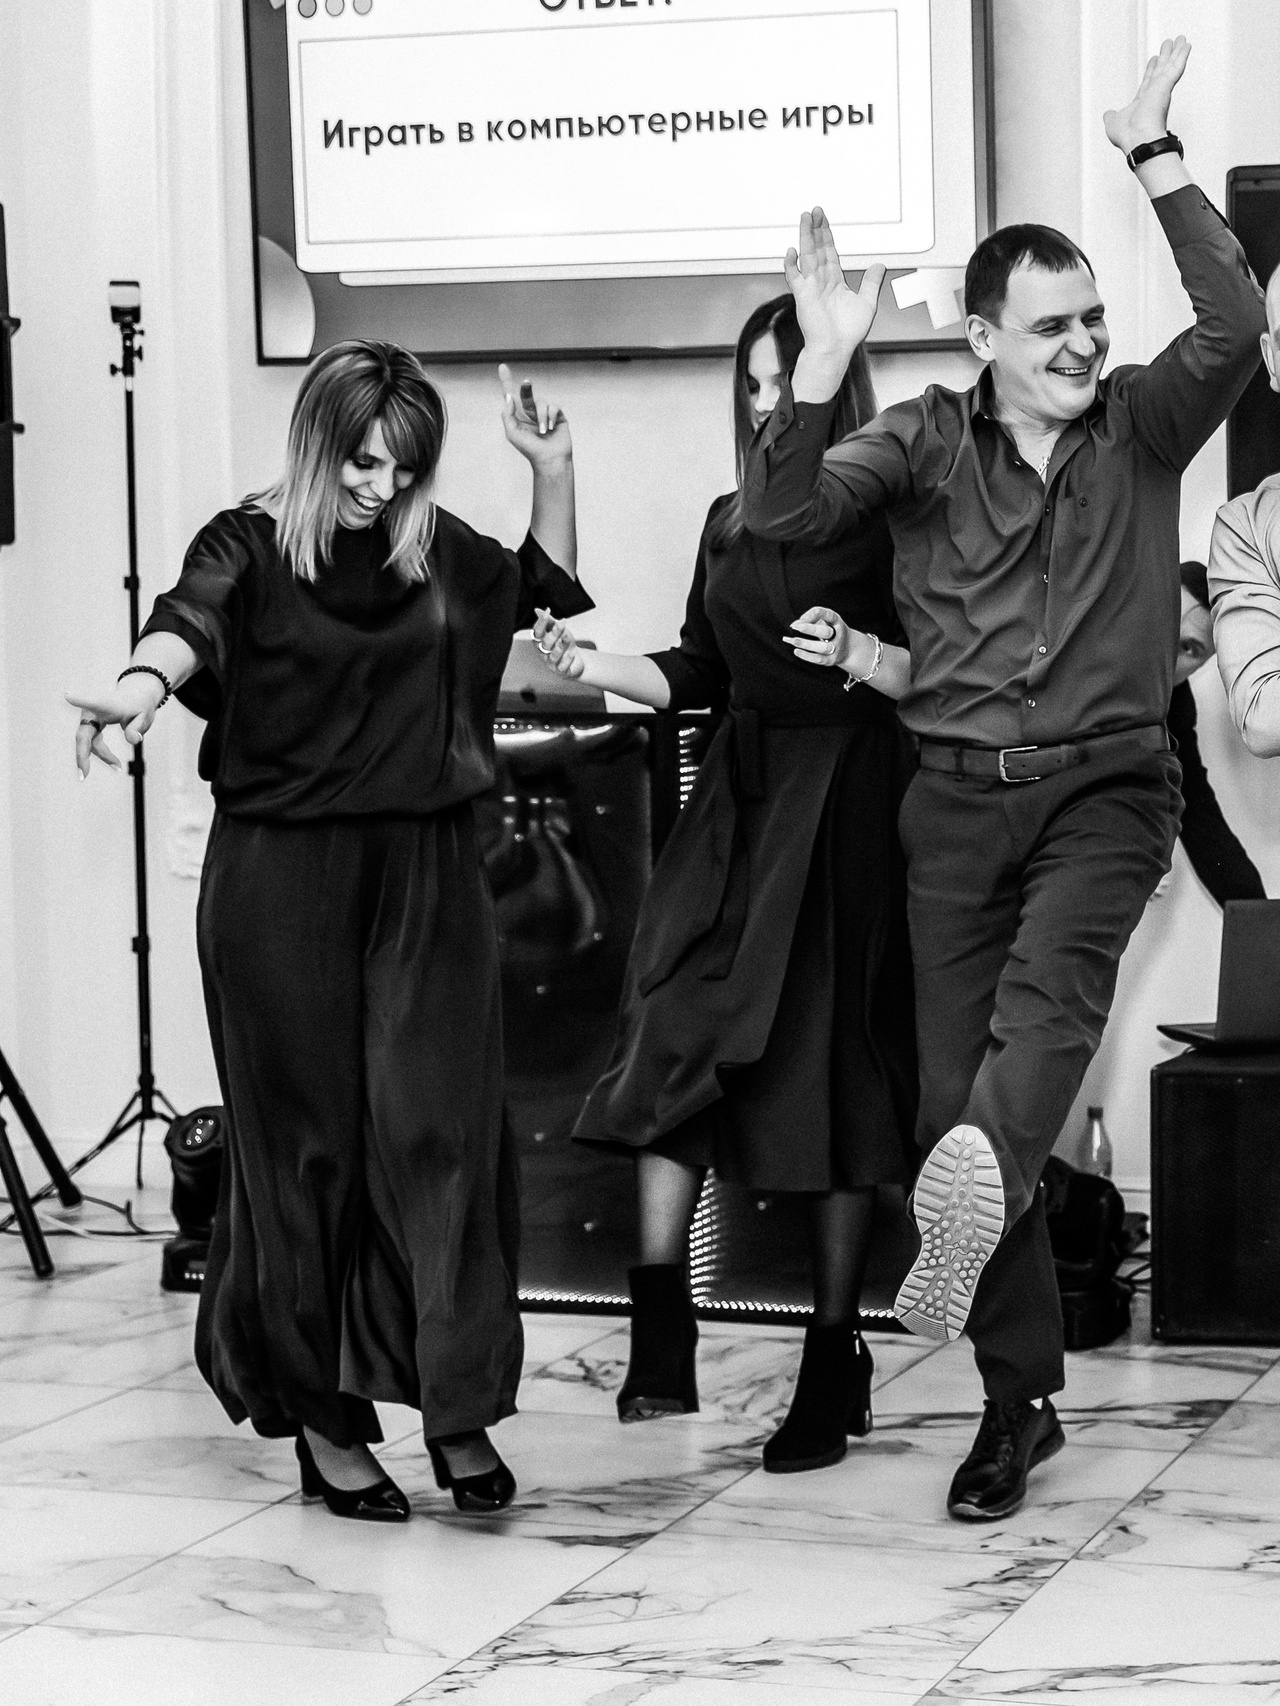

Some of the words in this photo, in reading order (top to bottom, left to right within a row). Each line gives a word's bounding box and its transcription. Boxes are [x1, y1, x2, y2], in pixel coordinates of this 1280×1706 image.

[323, 118, 446, 156] Играть
[457, 121, 475, 143] в
[487, 108, 768, 143] компьютерные
[782, 103, 874, 136] игры
